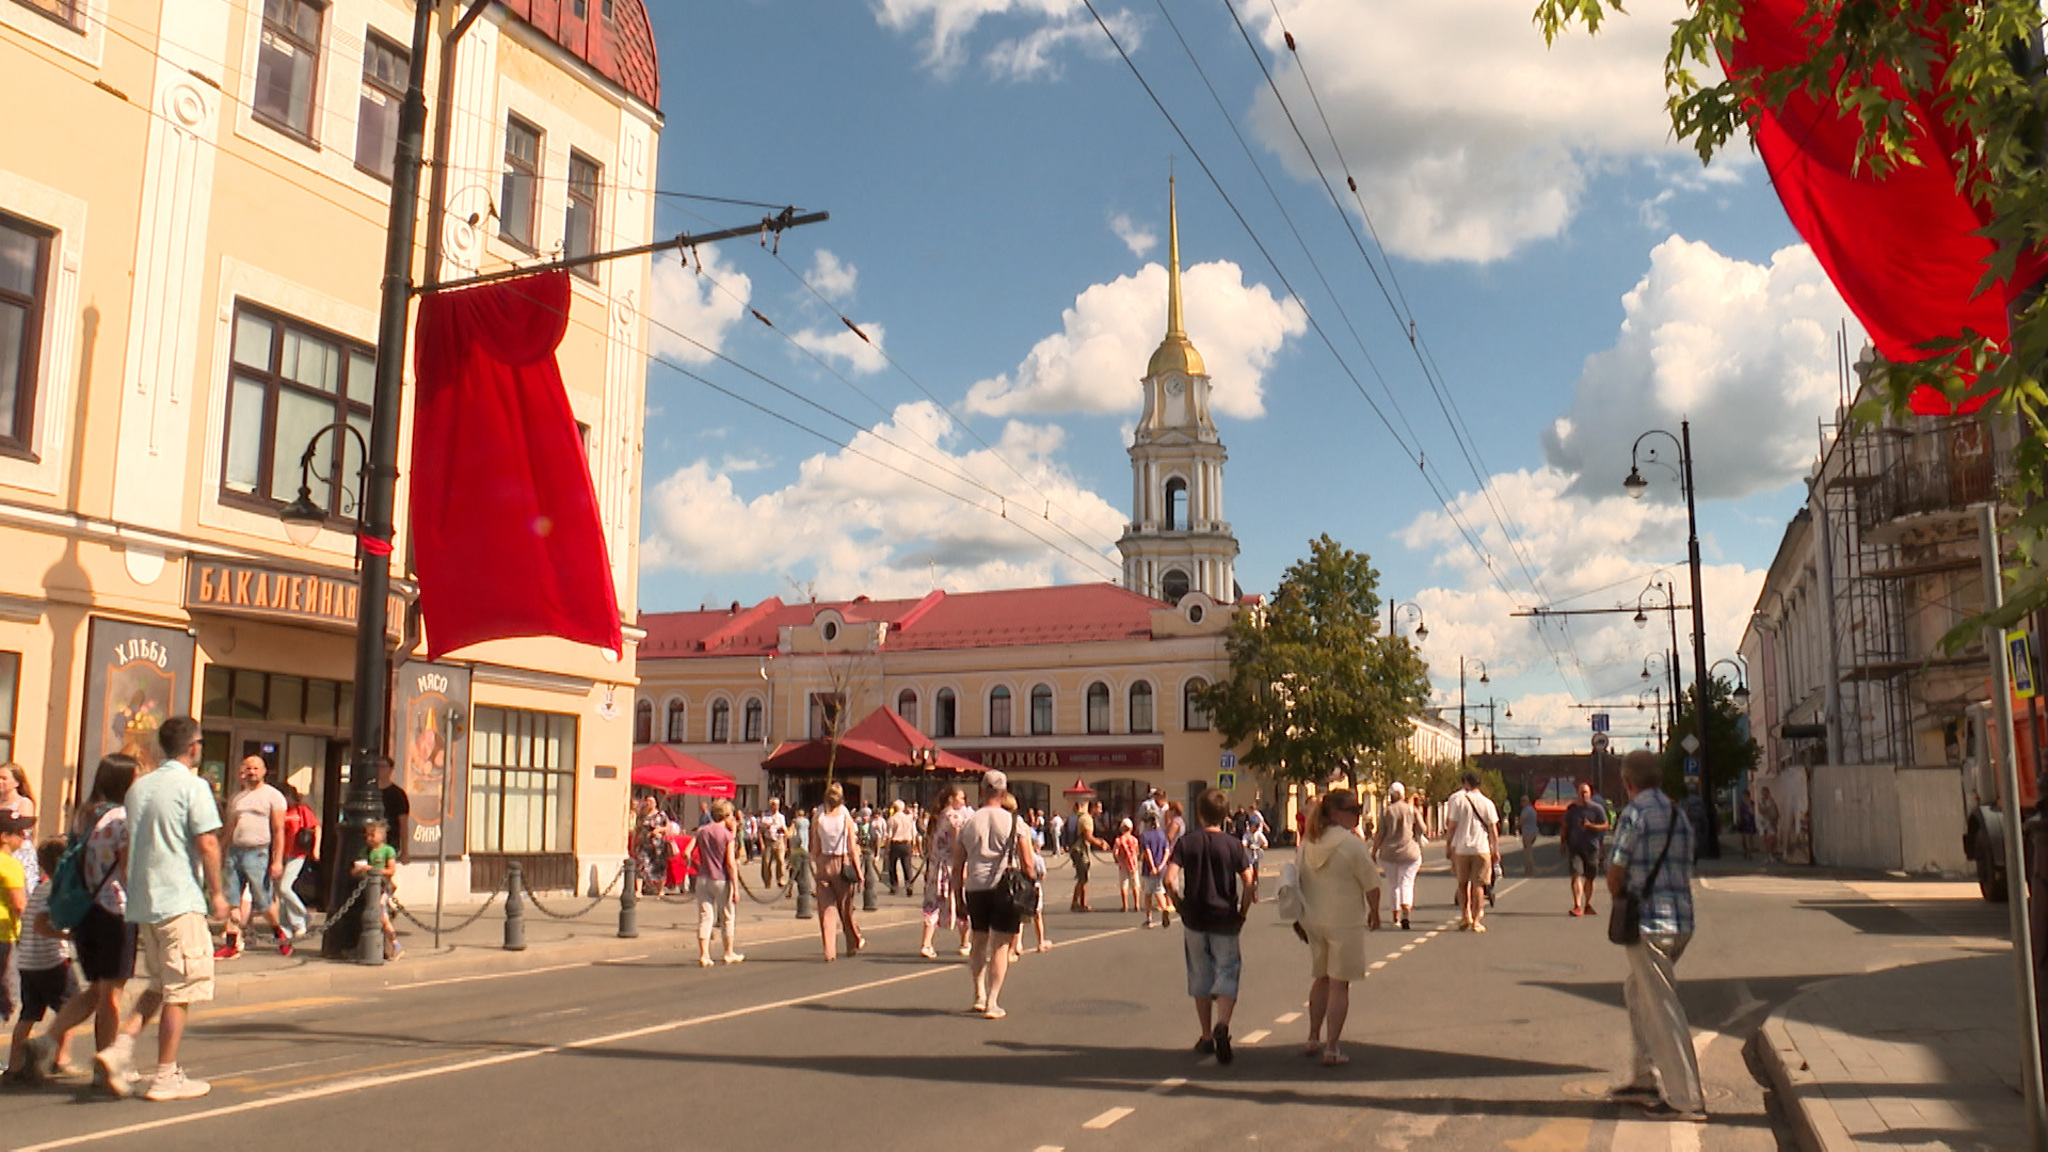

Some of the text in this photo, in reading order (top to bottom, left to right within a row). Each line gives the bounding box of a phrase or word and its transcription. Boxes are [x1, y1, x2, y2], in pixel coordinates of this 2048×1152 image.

[199, 566, 359, 620] БАКАЛЕЙНАЯ
[417, 672, 448, 694] МЯСО
[981, 751, 1059, 766] МАРКИЗА
[413, 824, 442, 842] ВИНА
